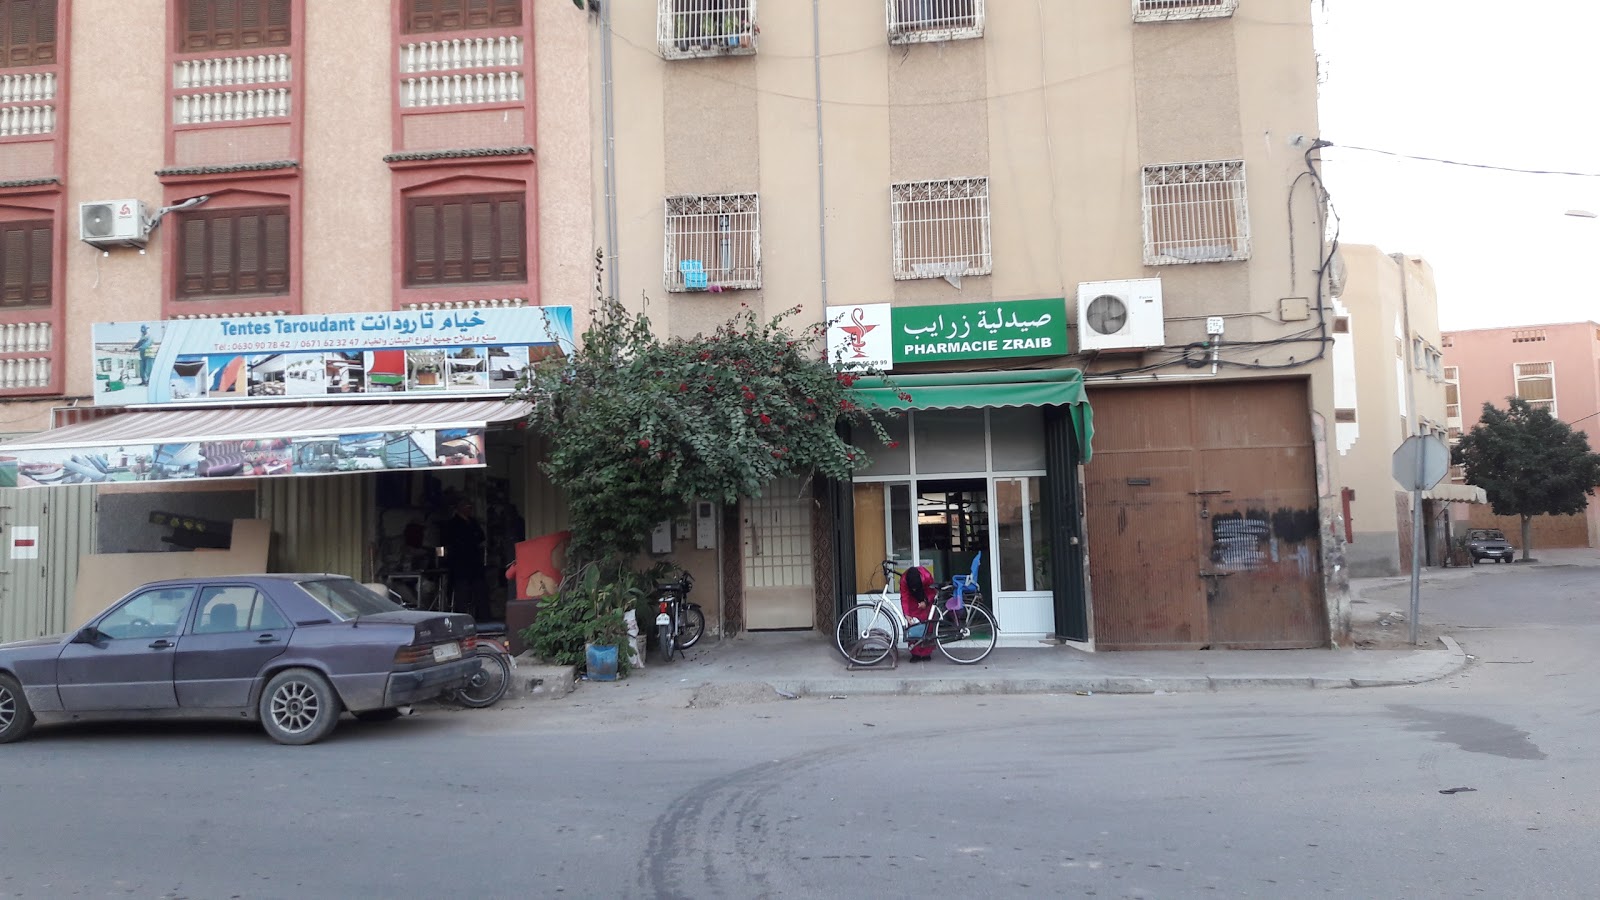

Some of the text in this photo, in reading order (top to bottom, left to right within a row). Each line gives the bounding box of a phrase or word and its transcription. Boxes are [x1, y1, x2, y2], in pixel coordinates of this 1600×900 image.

[220, 317, 356, 336] Tentes Taroudant
[439, 310, 486, 331] خيام
[903, 308, 1052, 341] صيدلية زرايب
[231, 342, 253, 350] 0630
[255, 341, 266, 350] 90
[267, 341, 278, 349] 78
[280, 340, 291, 349] 42
[300, 339, 321, 348] 0671
[323, 339, 334, 347] 62
[336, 338, 347, 347] 32
[349, 338, 360, 346] 47
[433, 336, 452, 345] جميع
[481, 333, 497, 344] صنع
[904, 337, 1053, 356] PHARMACIE ZRAIB
